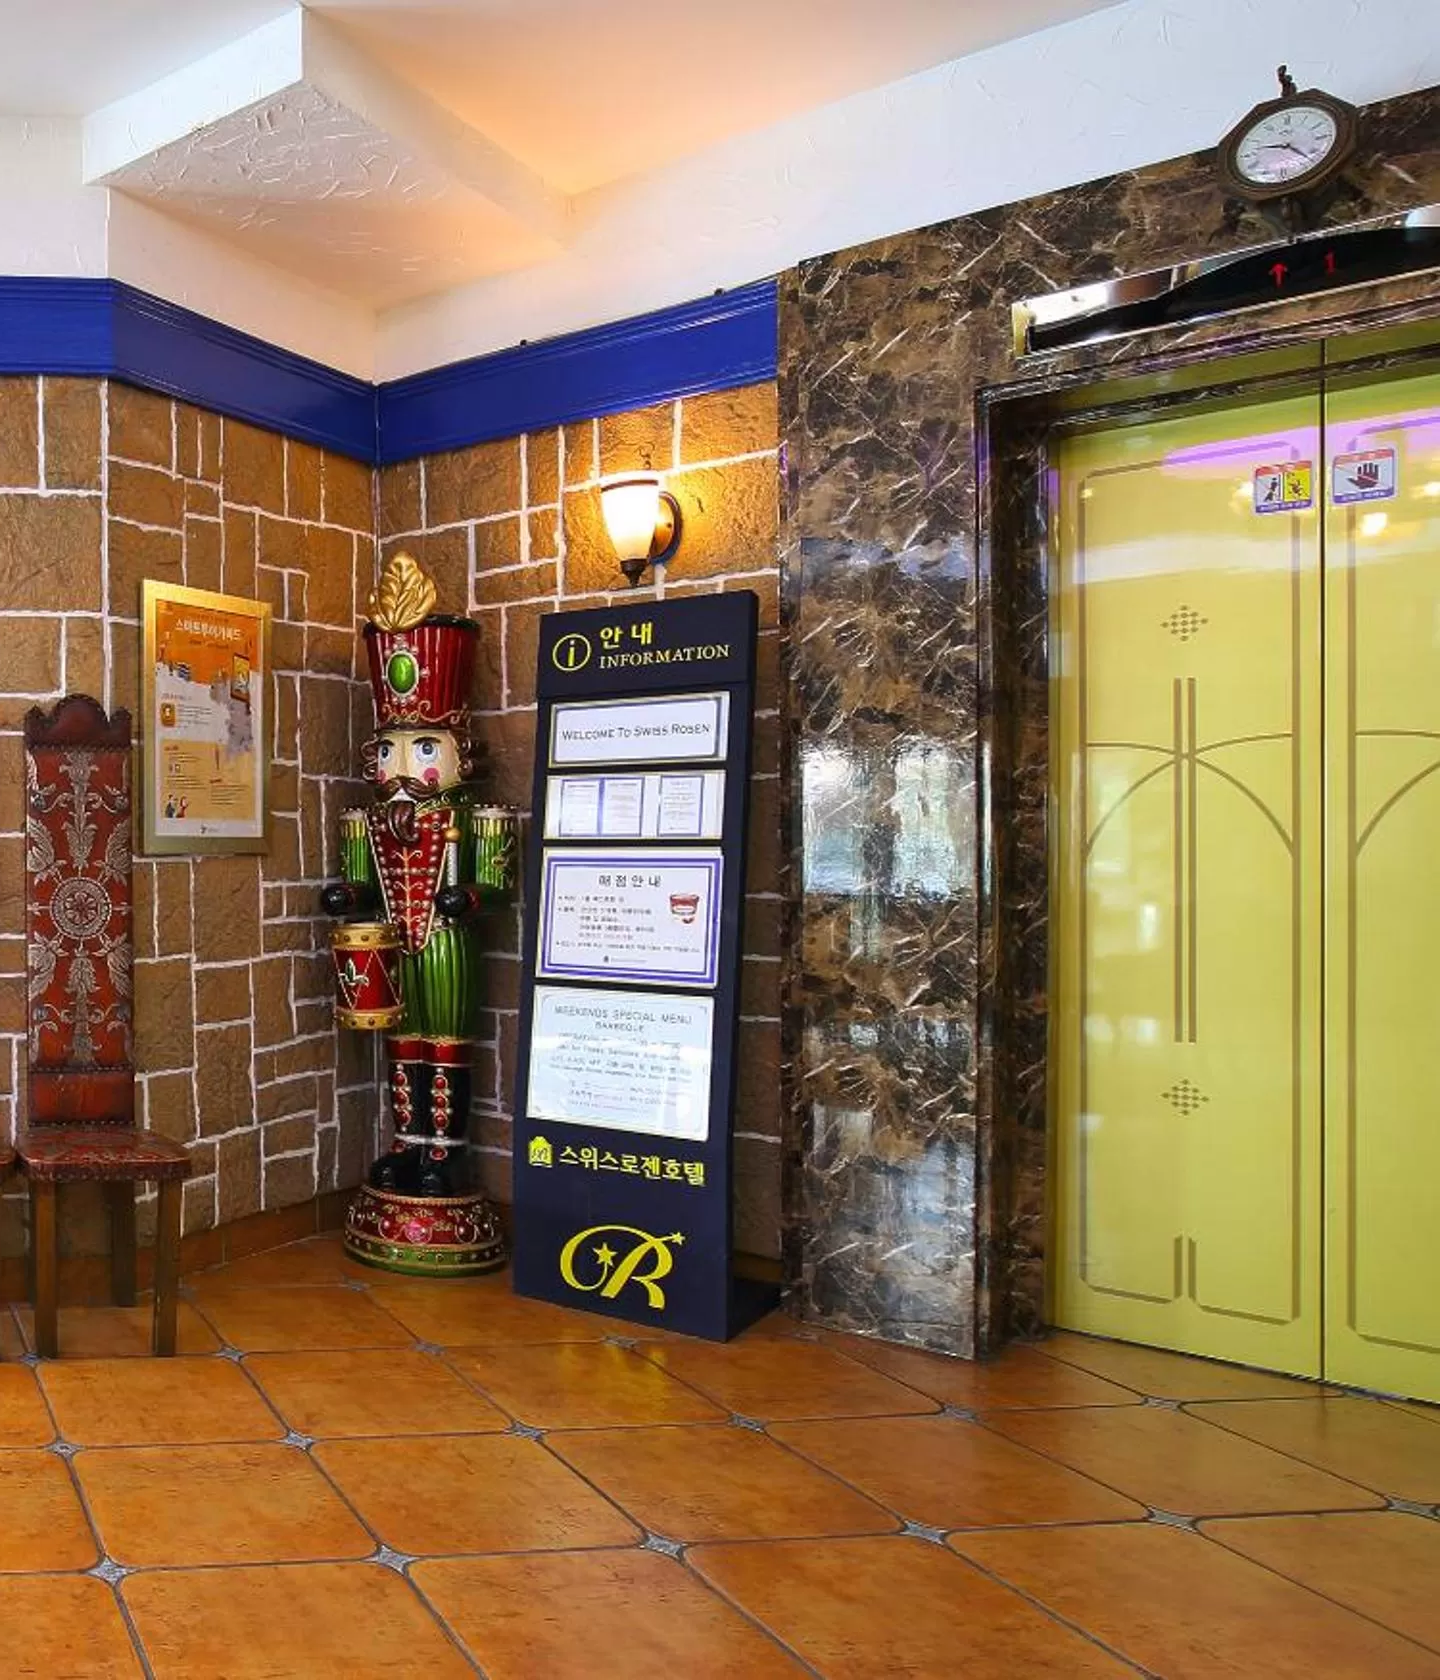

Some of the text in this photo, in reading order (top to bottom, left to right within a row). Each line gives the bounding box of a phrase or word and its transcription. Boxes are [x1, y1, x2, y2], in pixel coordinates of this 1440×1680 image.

[599, 643, 730, 669] INFORMATION
[562, 728, 614, 741] WELCOME
[633, 725, 668, 738] SWISS
[671, 723, 710, 736] ROSEN
[554, 1004, 693, 1025] WEEKENDS SPECIAL MENU
[559, 1144, 706, 1188] 스위스로젠호텔
